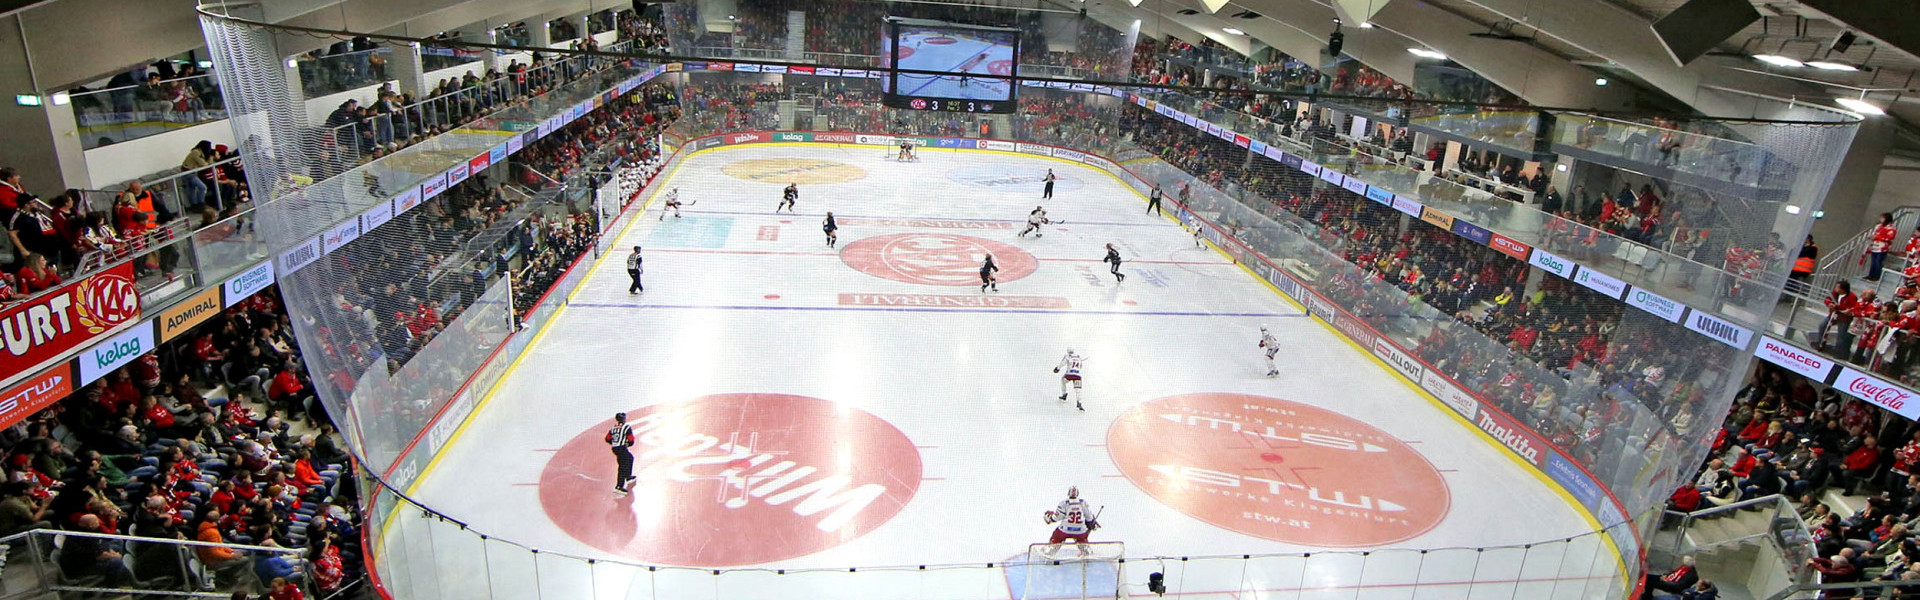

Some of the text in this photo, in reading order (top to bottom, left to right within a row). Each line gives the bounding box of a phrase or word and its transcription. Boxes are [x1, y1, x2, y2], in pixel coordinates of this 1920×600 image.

[931, 100, 939, 110] 3
[967, 102, 975, 112] 3
[1538, 251, 1563, 274] kelag
[242, 265, 267, 283] BUSINESS
[243, 273, 268, 291] SOFTWARE
[166, 298, 216, 332] ADMIRAL
[1344, 321, 1375, 348] GENERALI
[95, 336, 141, 370] kelag
[1390, 352, 1403, 367] ALL
[1765, 343, 1821, 369] PANACEO
[1068, 511, 1083, 524] 32
[1242, 510, 1312, 529] stw.at
[1284, 498, 1410, 526] Klagenfurt
